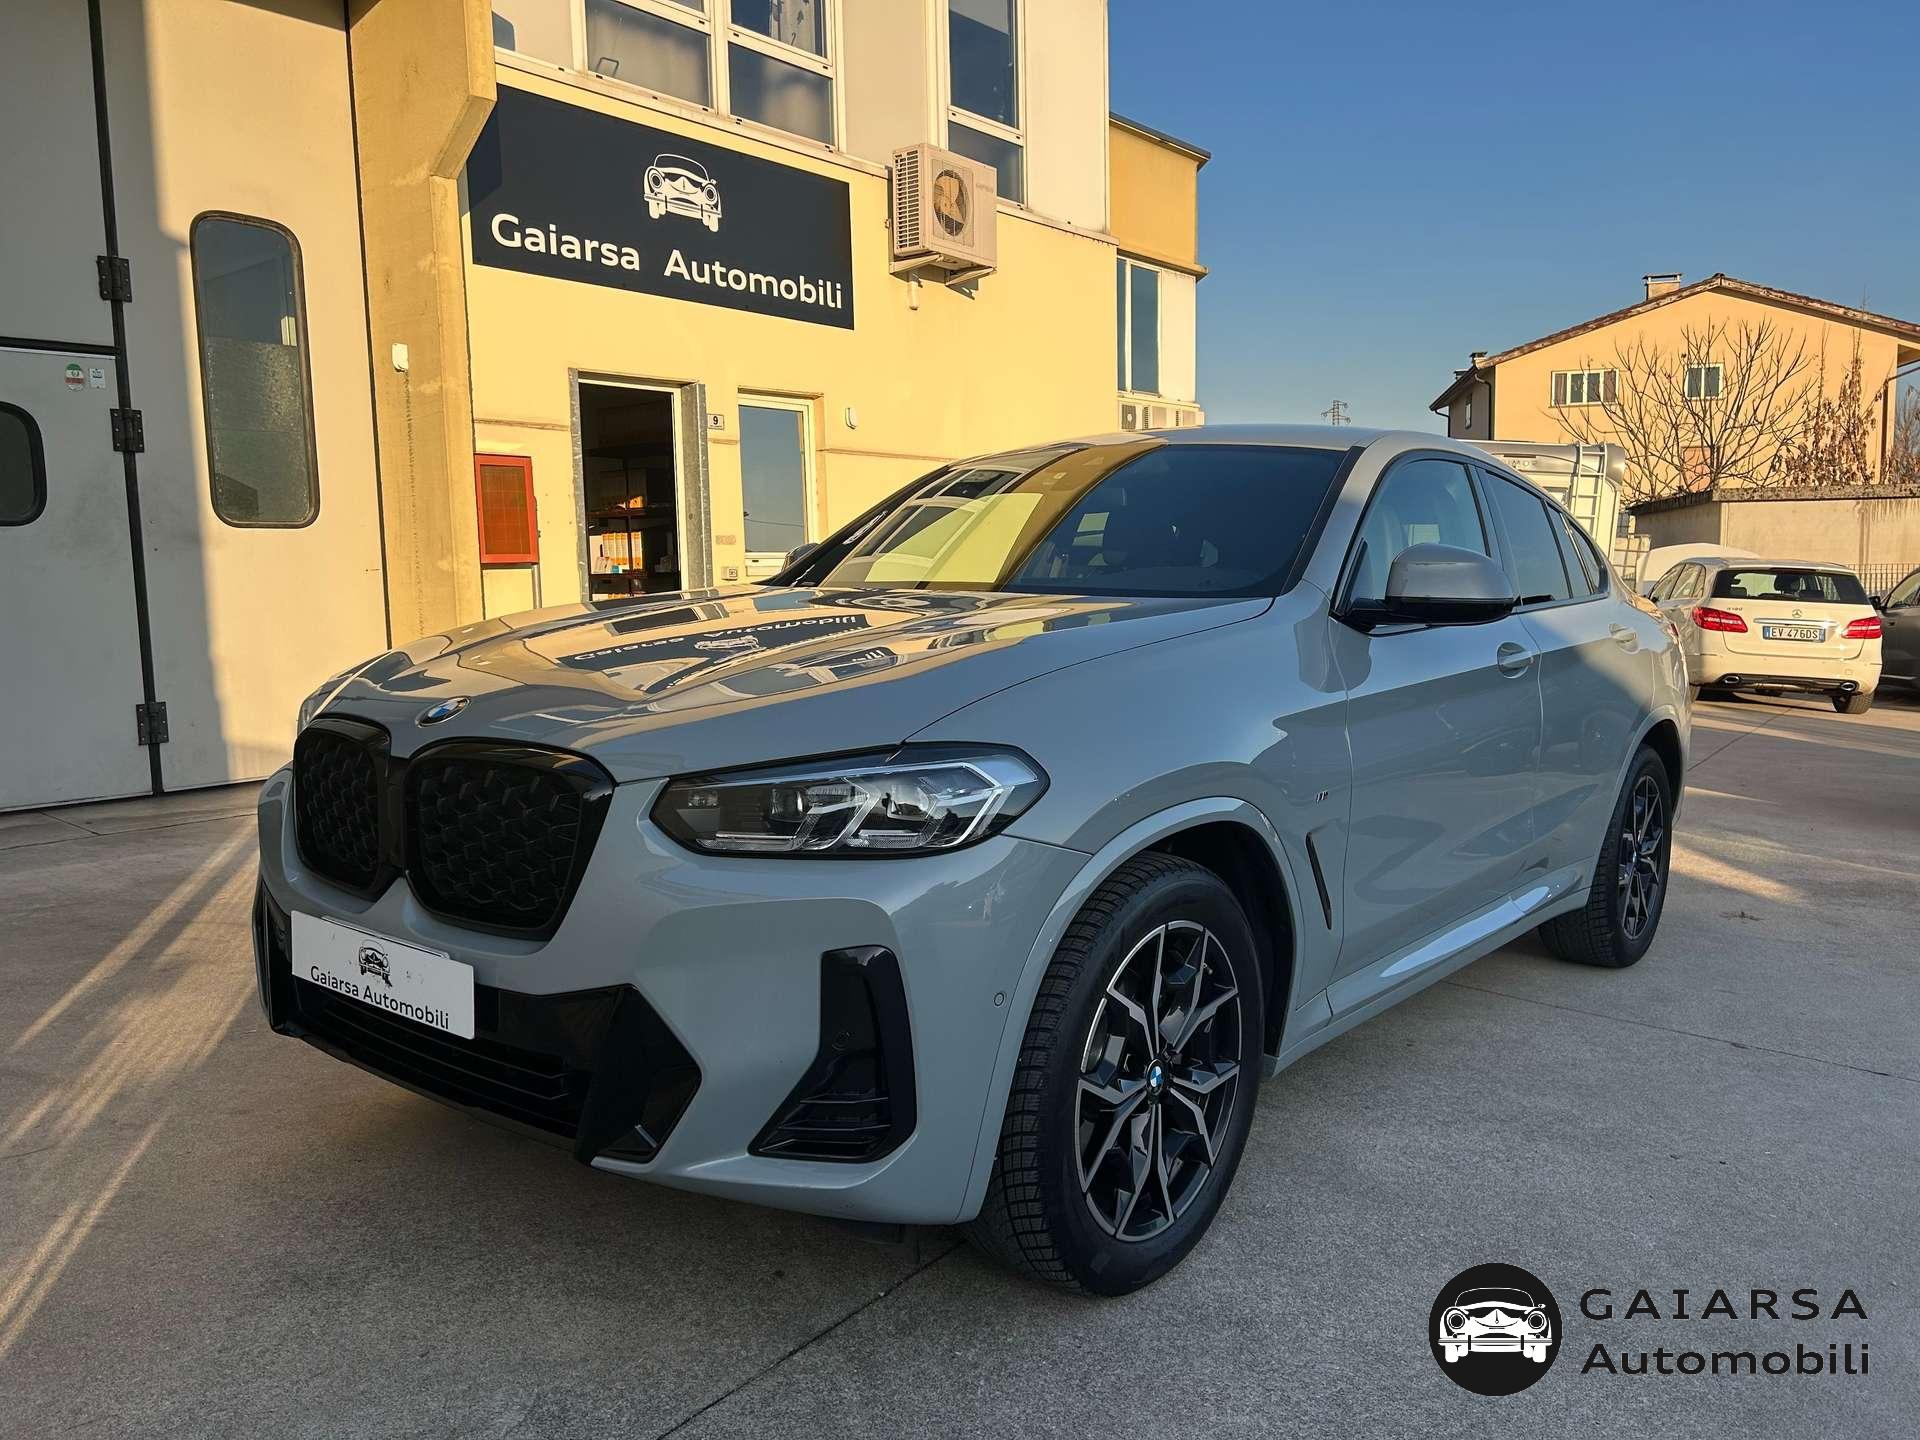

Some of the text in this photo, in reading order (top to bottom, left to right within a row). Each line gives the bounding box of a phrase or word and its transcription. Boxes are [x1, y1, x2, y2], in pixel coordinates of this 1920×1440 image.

[491, 213, 842, 309] Gaiarsa Automobili
[713, 415, 719, 425] 9
[310, 965, 449, 1030] Gaiarsa Automobili
